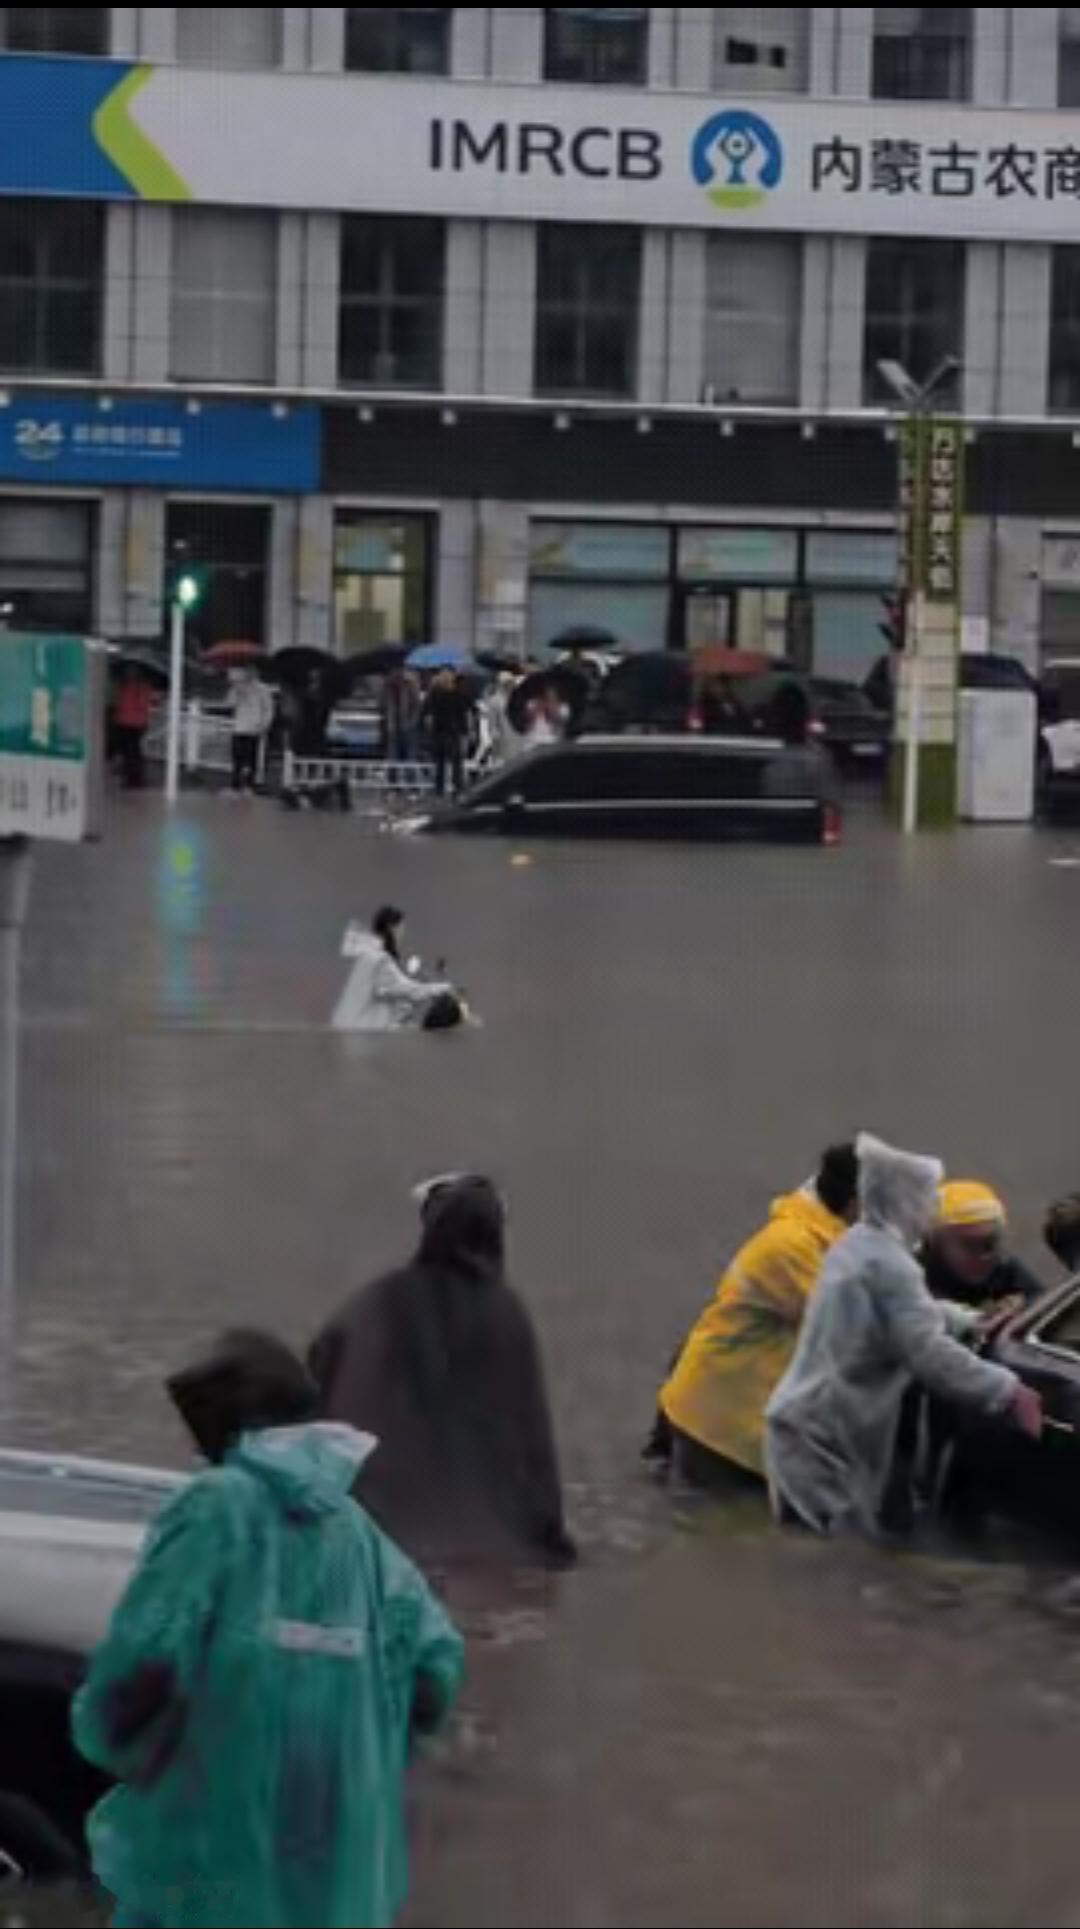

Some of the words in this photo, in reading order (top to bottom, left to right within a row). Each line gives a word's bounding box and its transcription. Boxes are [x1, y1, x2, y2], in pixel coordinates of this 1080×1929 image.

[430, 118, 663, 180] IMRCB
[811, 134, 1080, 200] 内蒙古农商
[14, 418, 63, 446] 24
